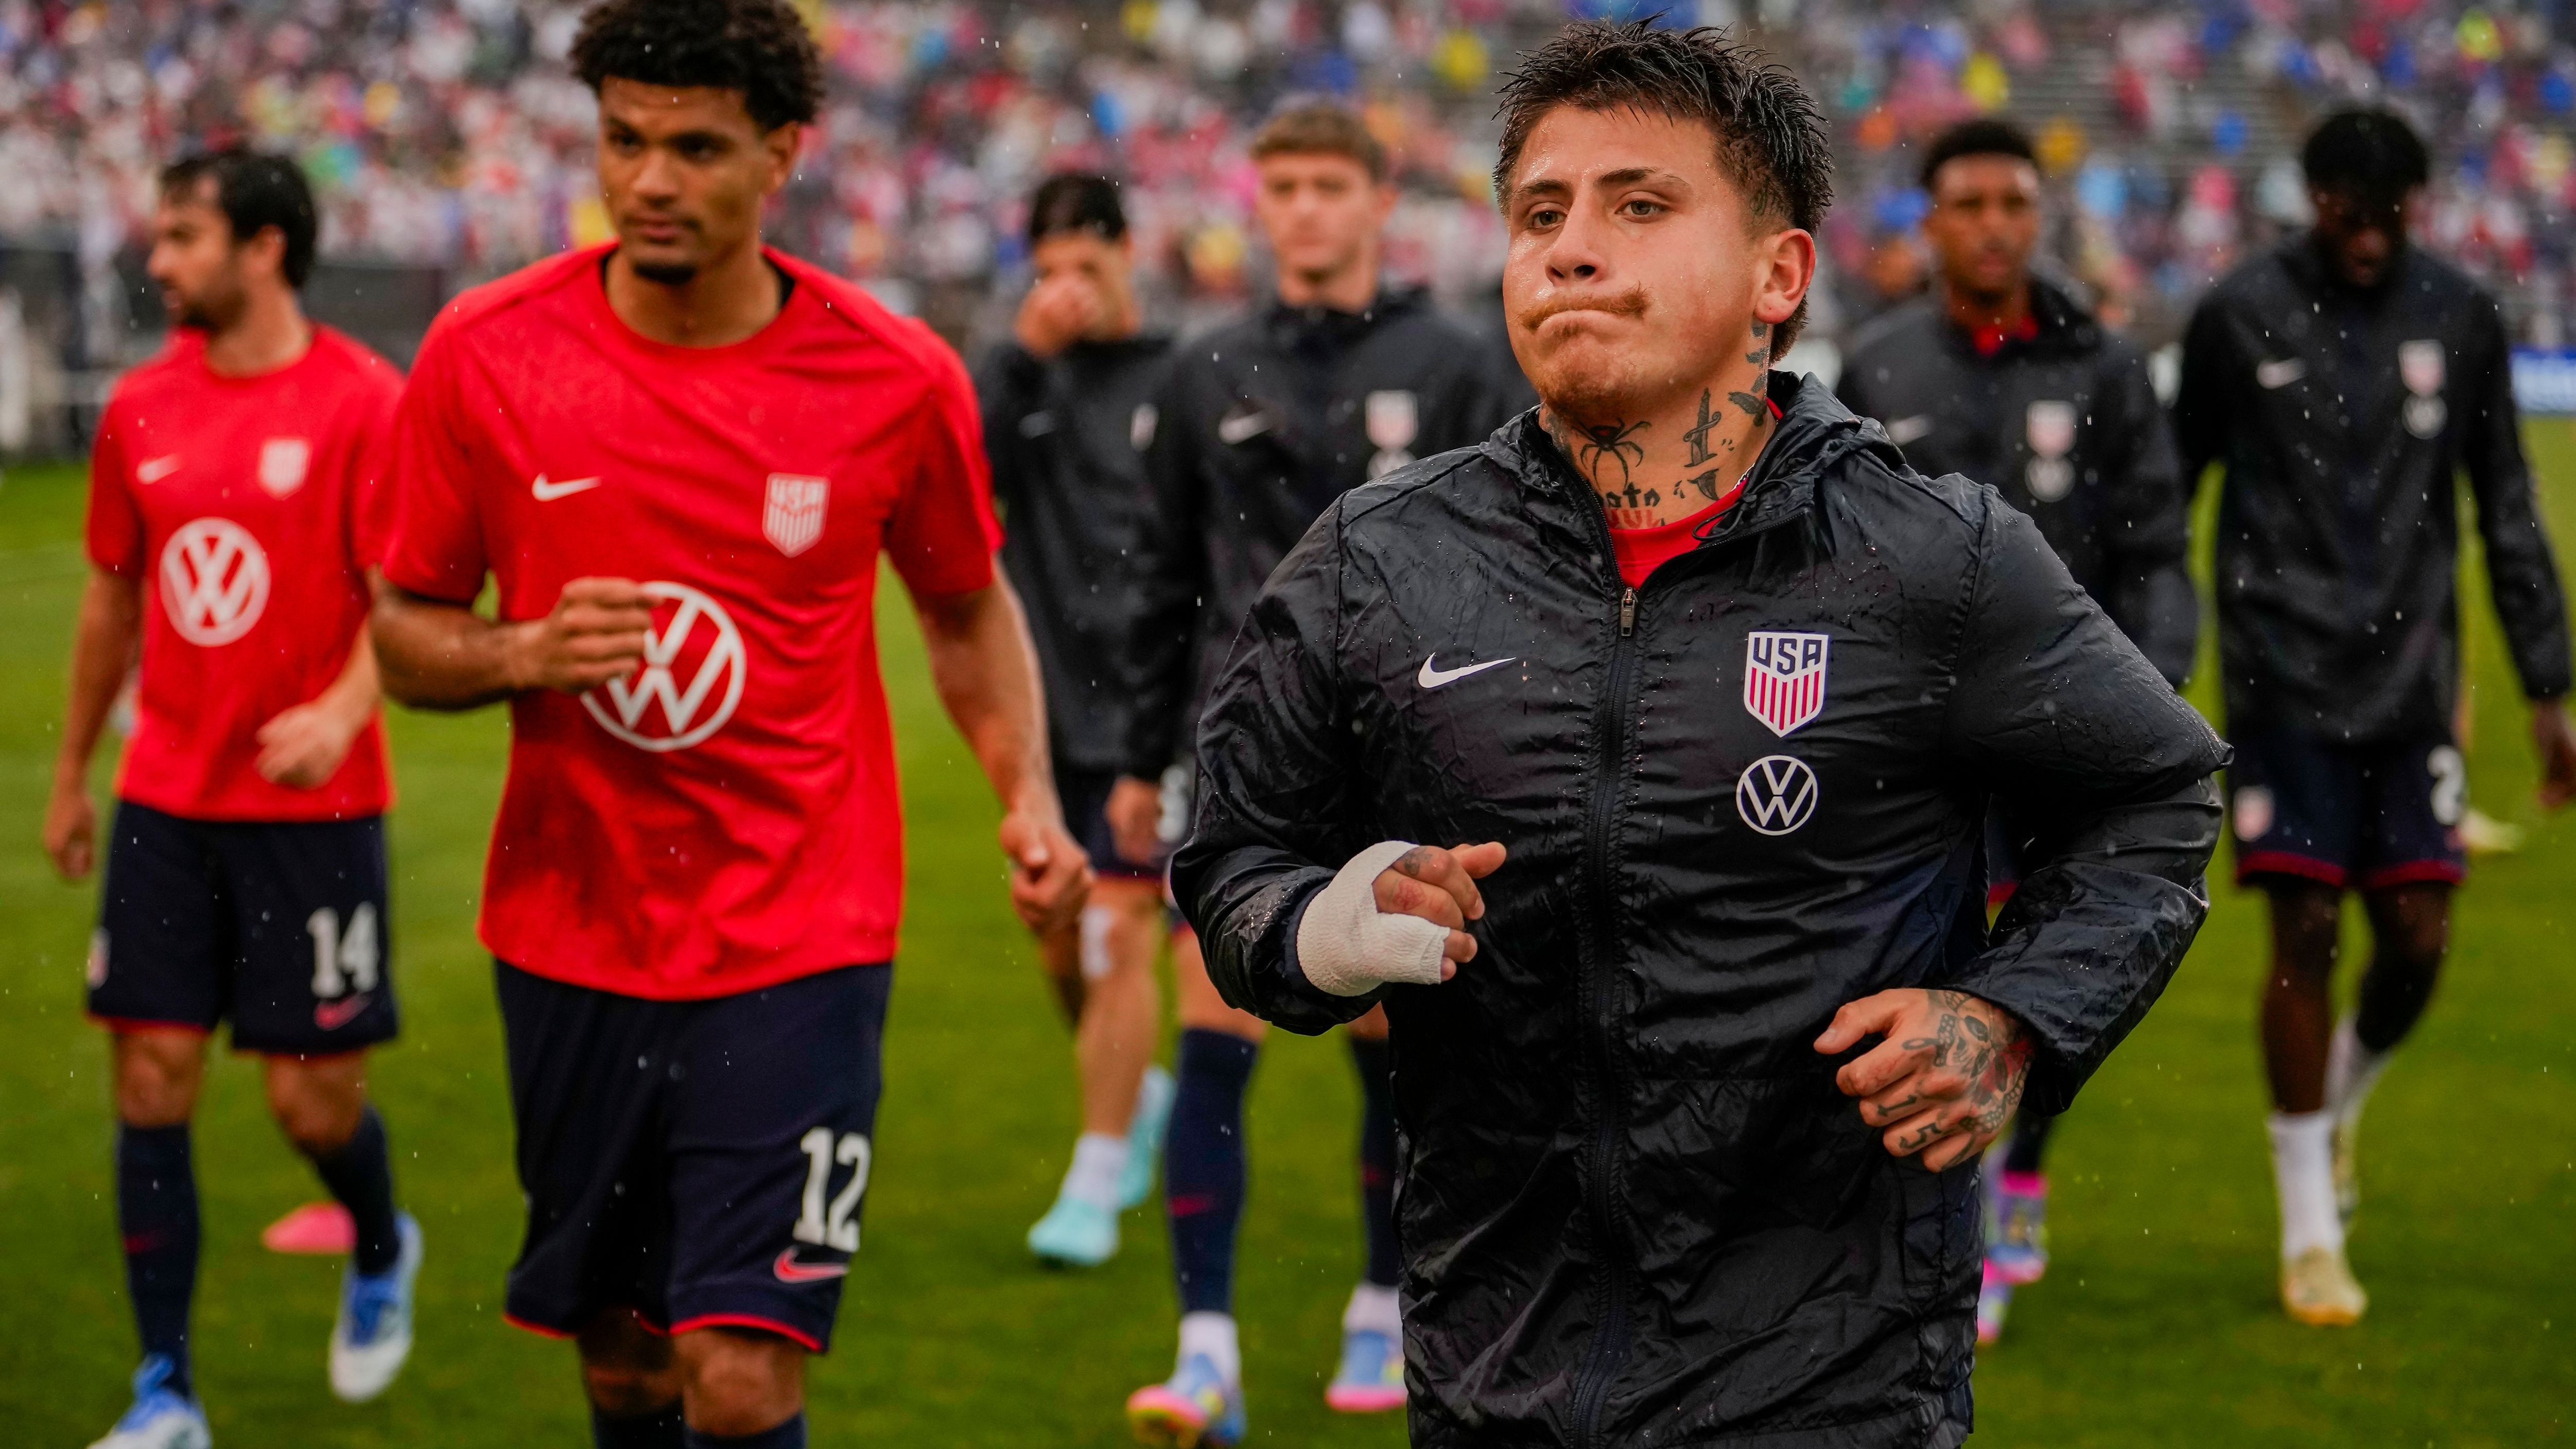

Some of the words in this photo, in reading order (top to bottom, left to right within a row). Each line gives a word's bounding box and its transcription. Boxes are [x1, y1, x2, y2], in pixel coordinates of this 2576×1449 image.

[163, 524, 264, 636] VW
[1752, 637, 1822, 676] USA
[1742, 759, 1814, 828] VW
[307, 900, 379, 999] 14
[792, 1126, 872, 1253] 12
